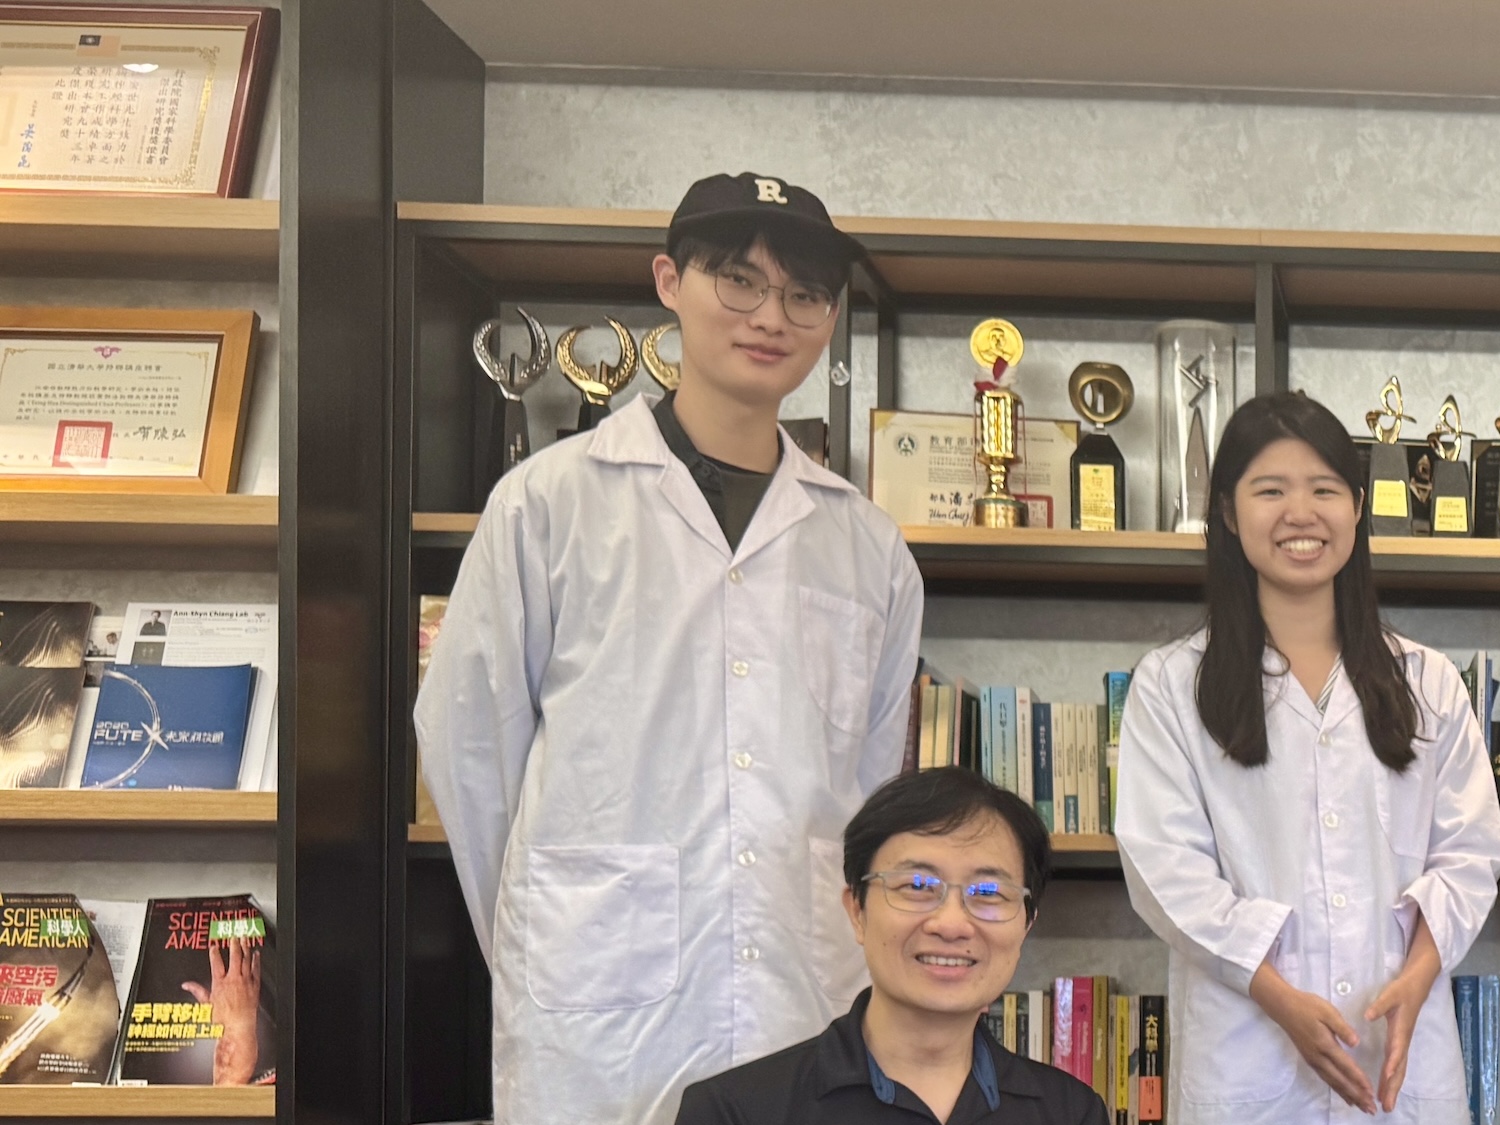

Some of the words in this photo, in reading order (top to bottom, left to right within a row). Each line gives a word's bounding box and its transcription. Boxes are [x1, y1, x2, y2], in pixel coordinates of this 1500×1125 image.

[754, 178, 788, 205] R
[47, 919, 85, 936] 科學人
[217, 920, 261, 937] 科學人
[132, 1002, 213, 1023] 手臂移植
